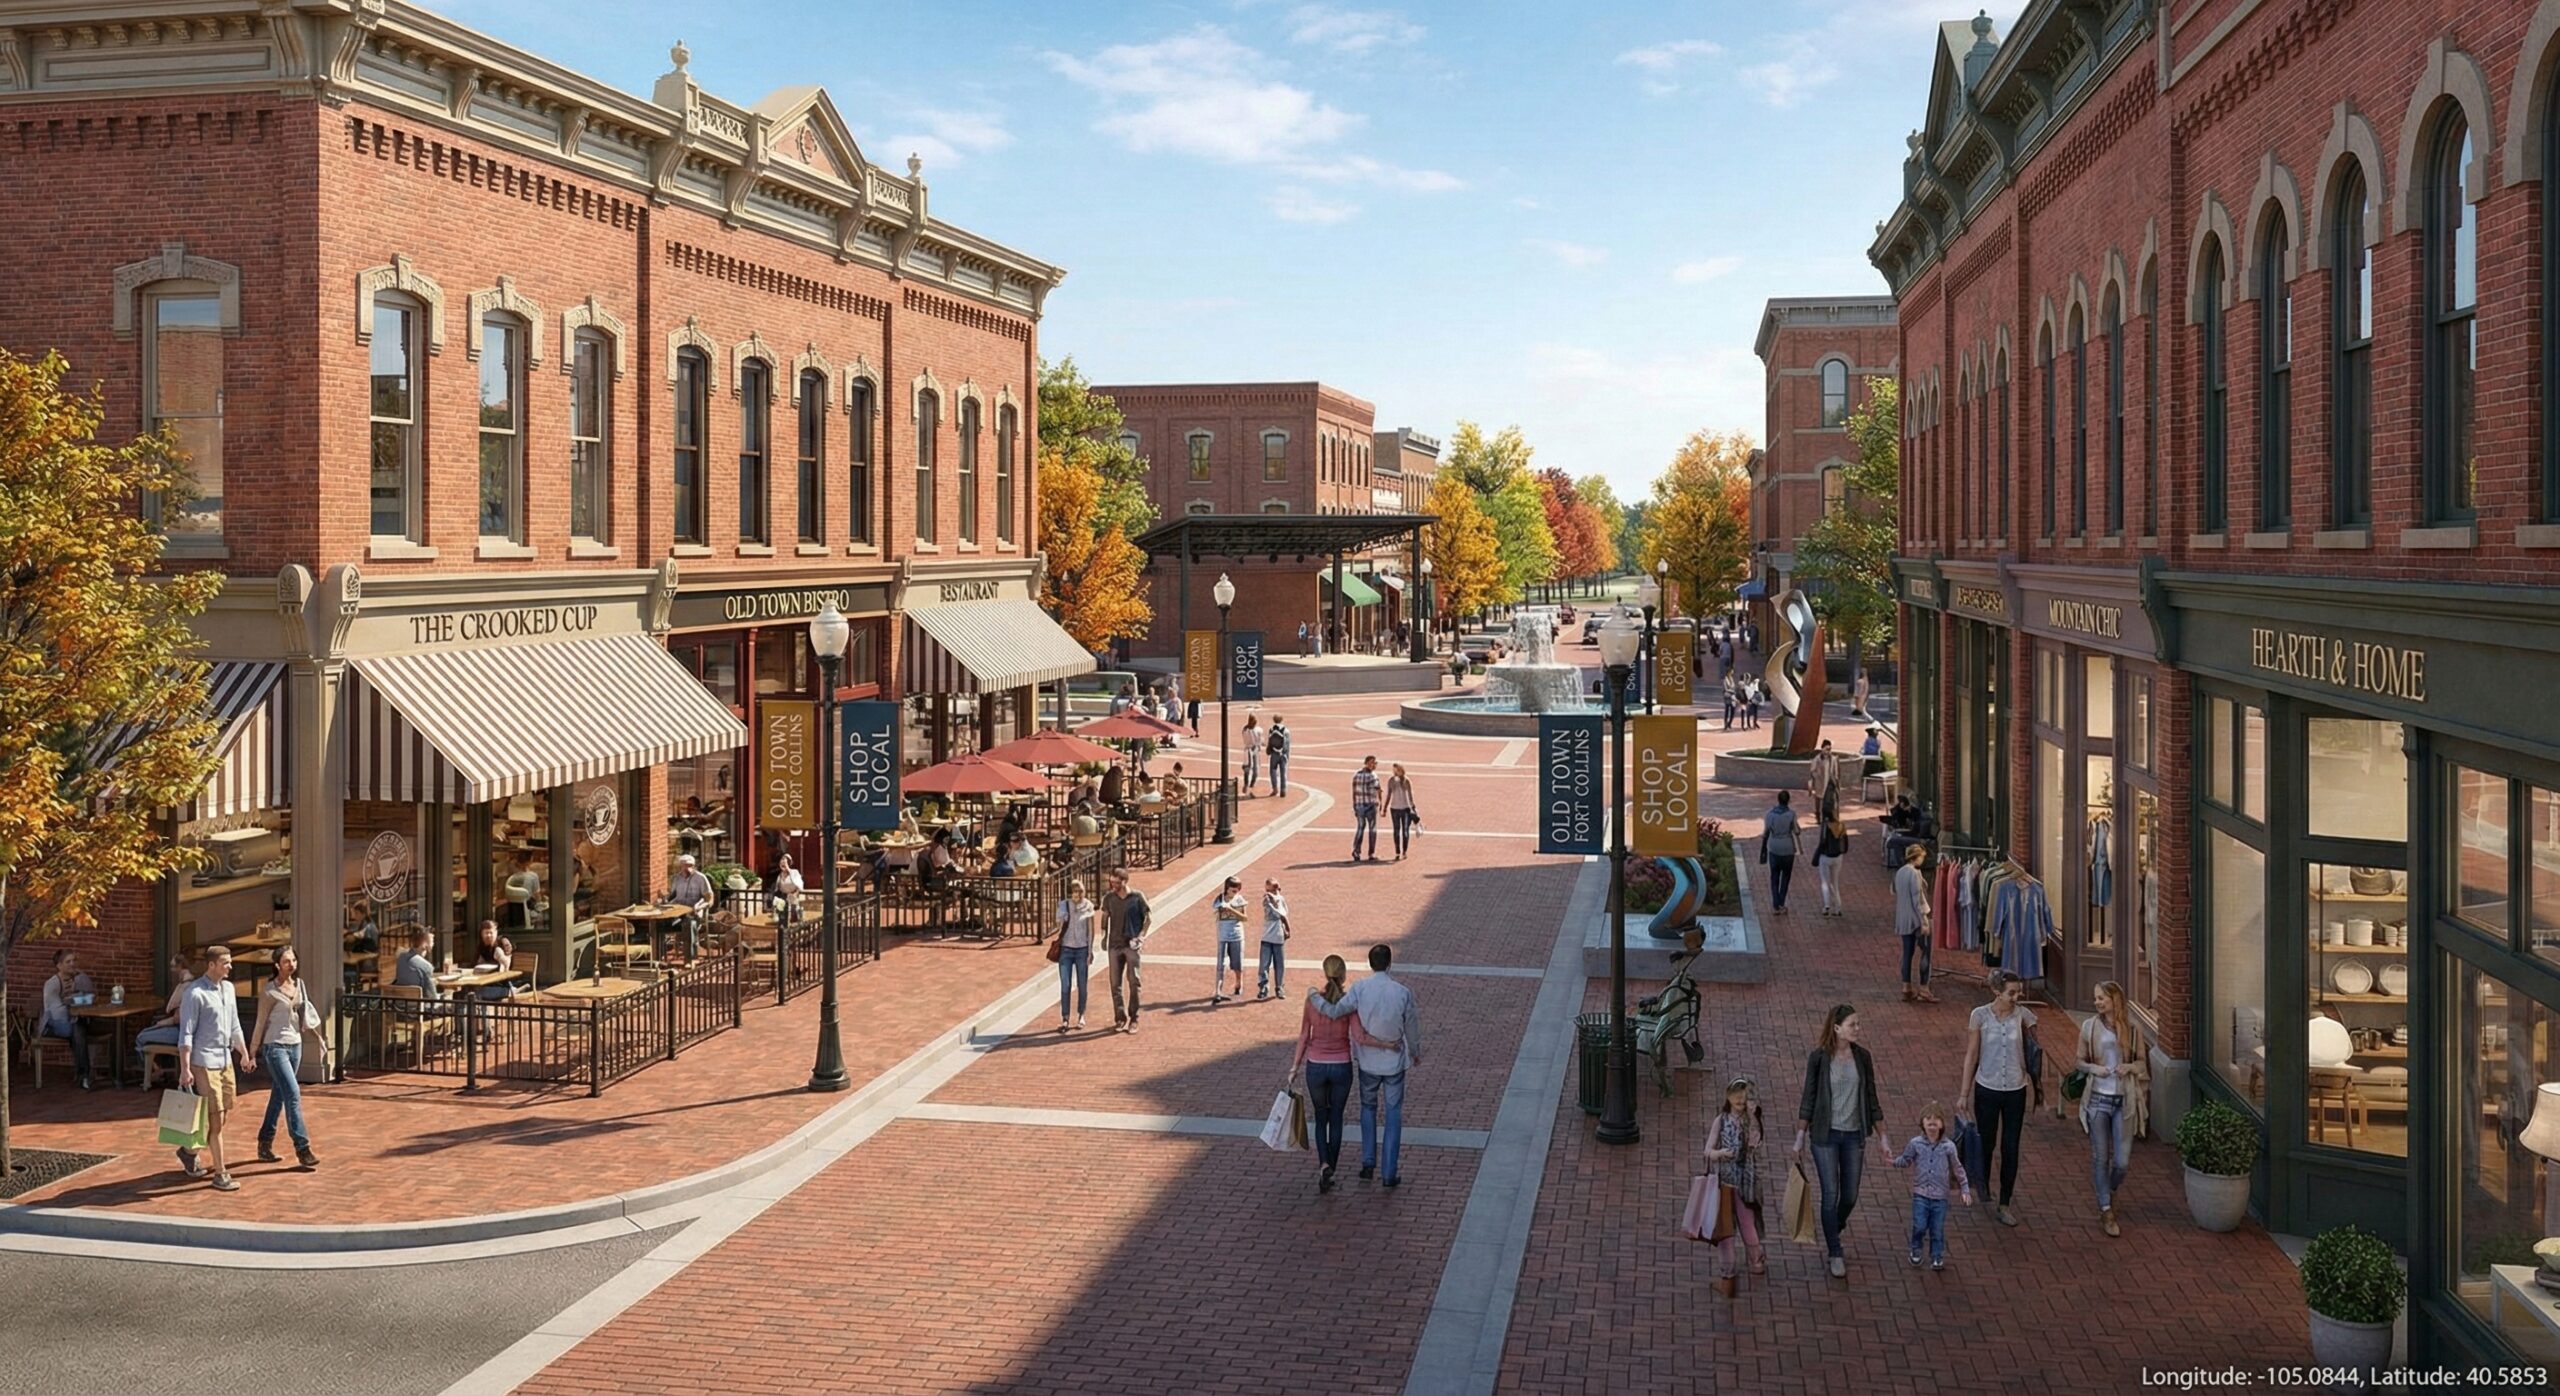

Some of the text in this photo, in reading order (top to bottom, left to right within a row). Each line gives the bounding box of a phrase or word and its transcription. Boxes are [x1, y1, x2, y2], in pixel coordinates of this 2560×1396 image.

[410, 605, 598, 644] THE CROOKED CUP
[725, 595, 757, 620] OLD
[759, 591, 801, 616] TOWN
[2096, 606, 2121, 639] CHIC
[1246, 641, 1259, 688] LOCAL
[1660, 647, 1674, 686] SHOP
[1673, 645, 1687, 692] LOCAL
[2252, 628, 2426, 701] HEARTH & HOME
[770, 715, 788, 818] OLD TOWN
[789, 714, 803, 818] FORT COLLINS
[849, 732, 869, 803] SHOP
[871, 724, 890, 807] LOCAL
[1551, 729, 1571, 843] OLD TOWN
[1574, 728, 1590, 842] FORT COLLINS
[1642, 748, 1664, 825] SHOP
[1666, 743, 1689, 832] LOCAL
